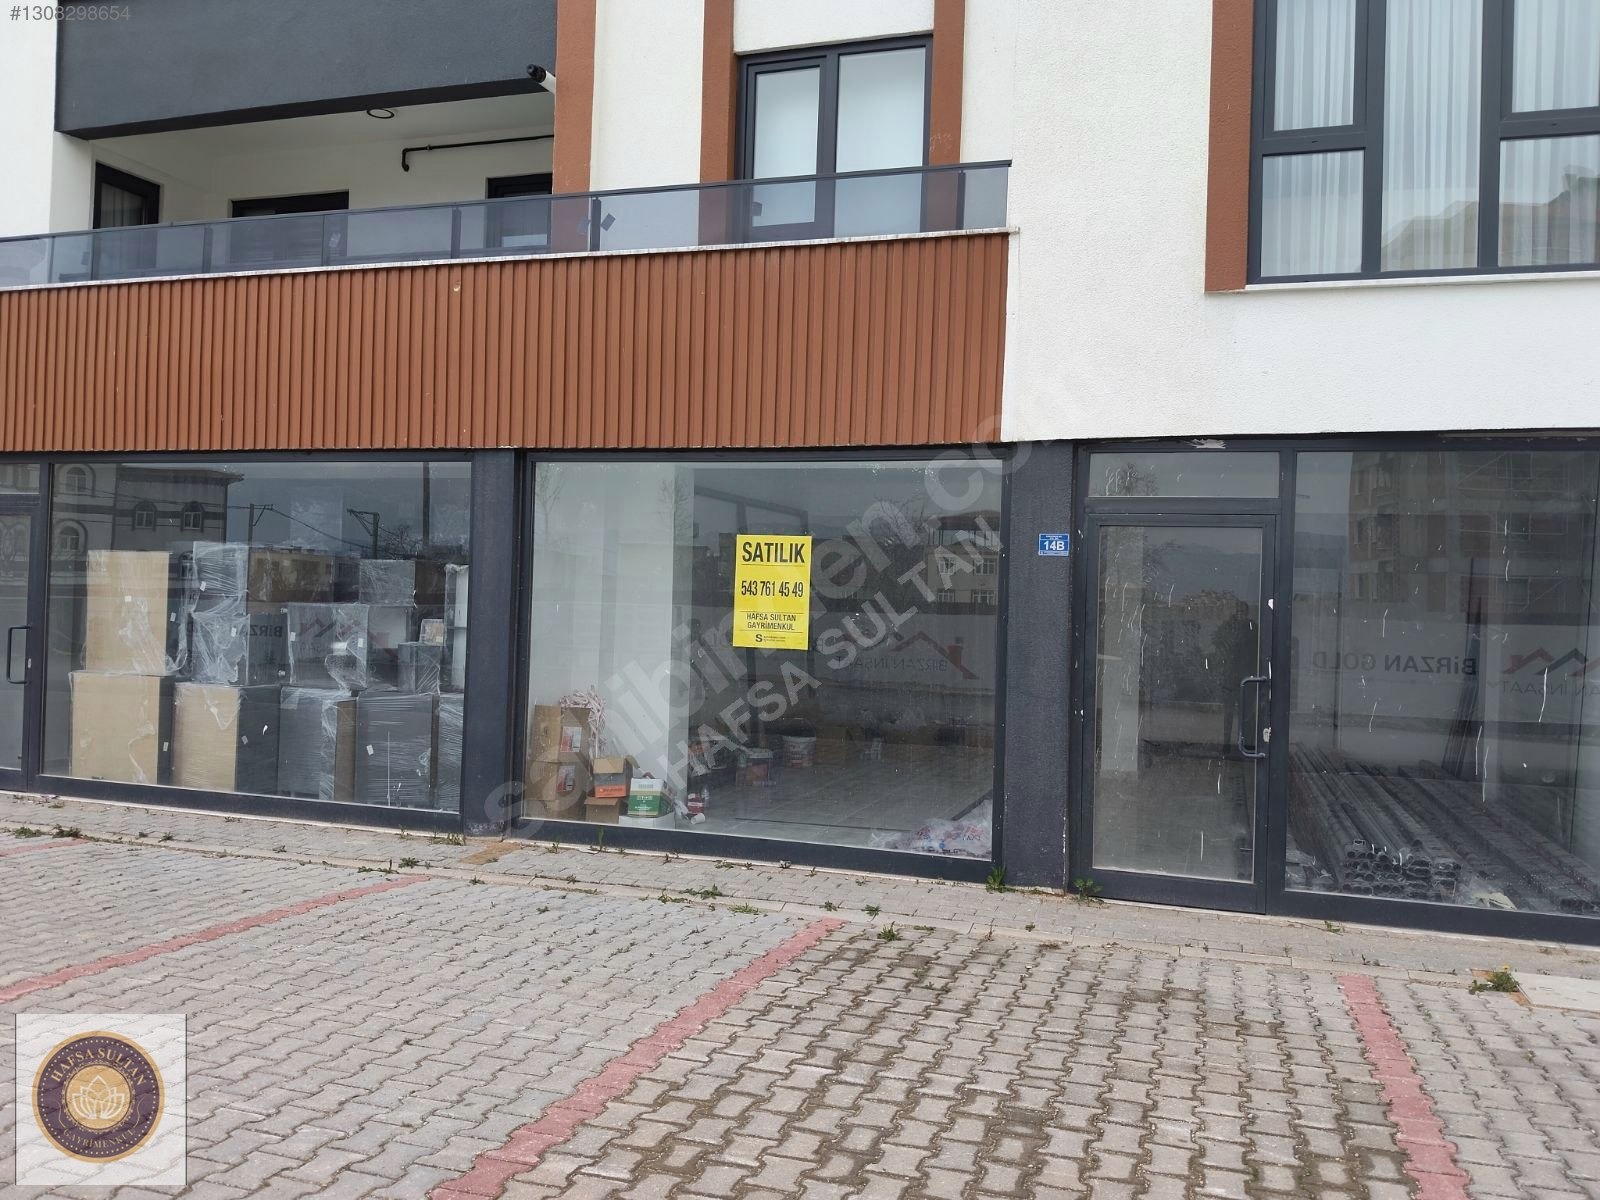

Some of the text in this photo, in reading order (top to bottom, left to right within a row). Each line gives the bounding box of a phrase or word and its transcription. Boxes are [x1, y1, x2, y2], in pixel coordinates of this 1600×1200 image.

[742, 541, 805, 563] SATILIK
[1043, 540, 1065, 551] 14B
[741, 580, 804, 598] 543 761 45 49
[746, 612, 796, 621] HAFSA SULTAN
